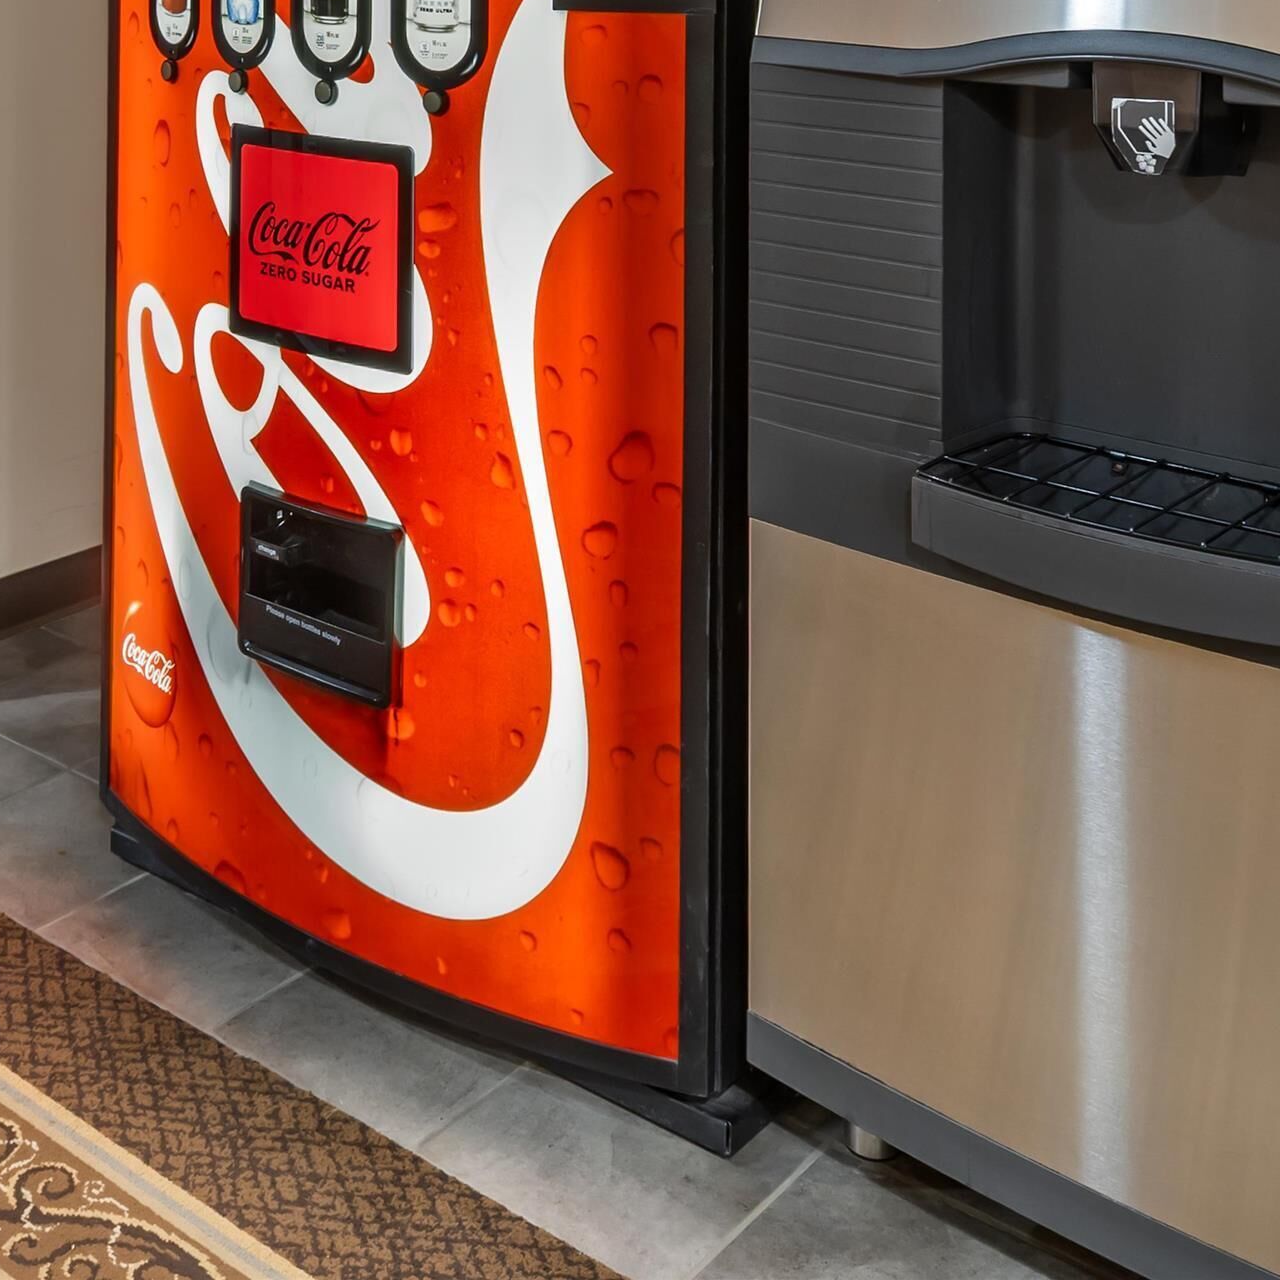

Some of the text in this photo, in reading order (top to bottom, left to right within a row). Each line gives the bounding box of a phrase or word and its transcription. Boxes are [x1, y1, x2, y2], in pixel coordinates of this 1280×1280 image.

[248, 201, 381, 276] Coca-Cola
[260, 261, 356, 293] ZERO SUGAR
[265, 604, 285, 619] Please
[122, 632, 176, 693] Coca-Cola
